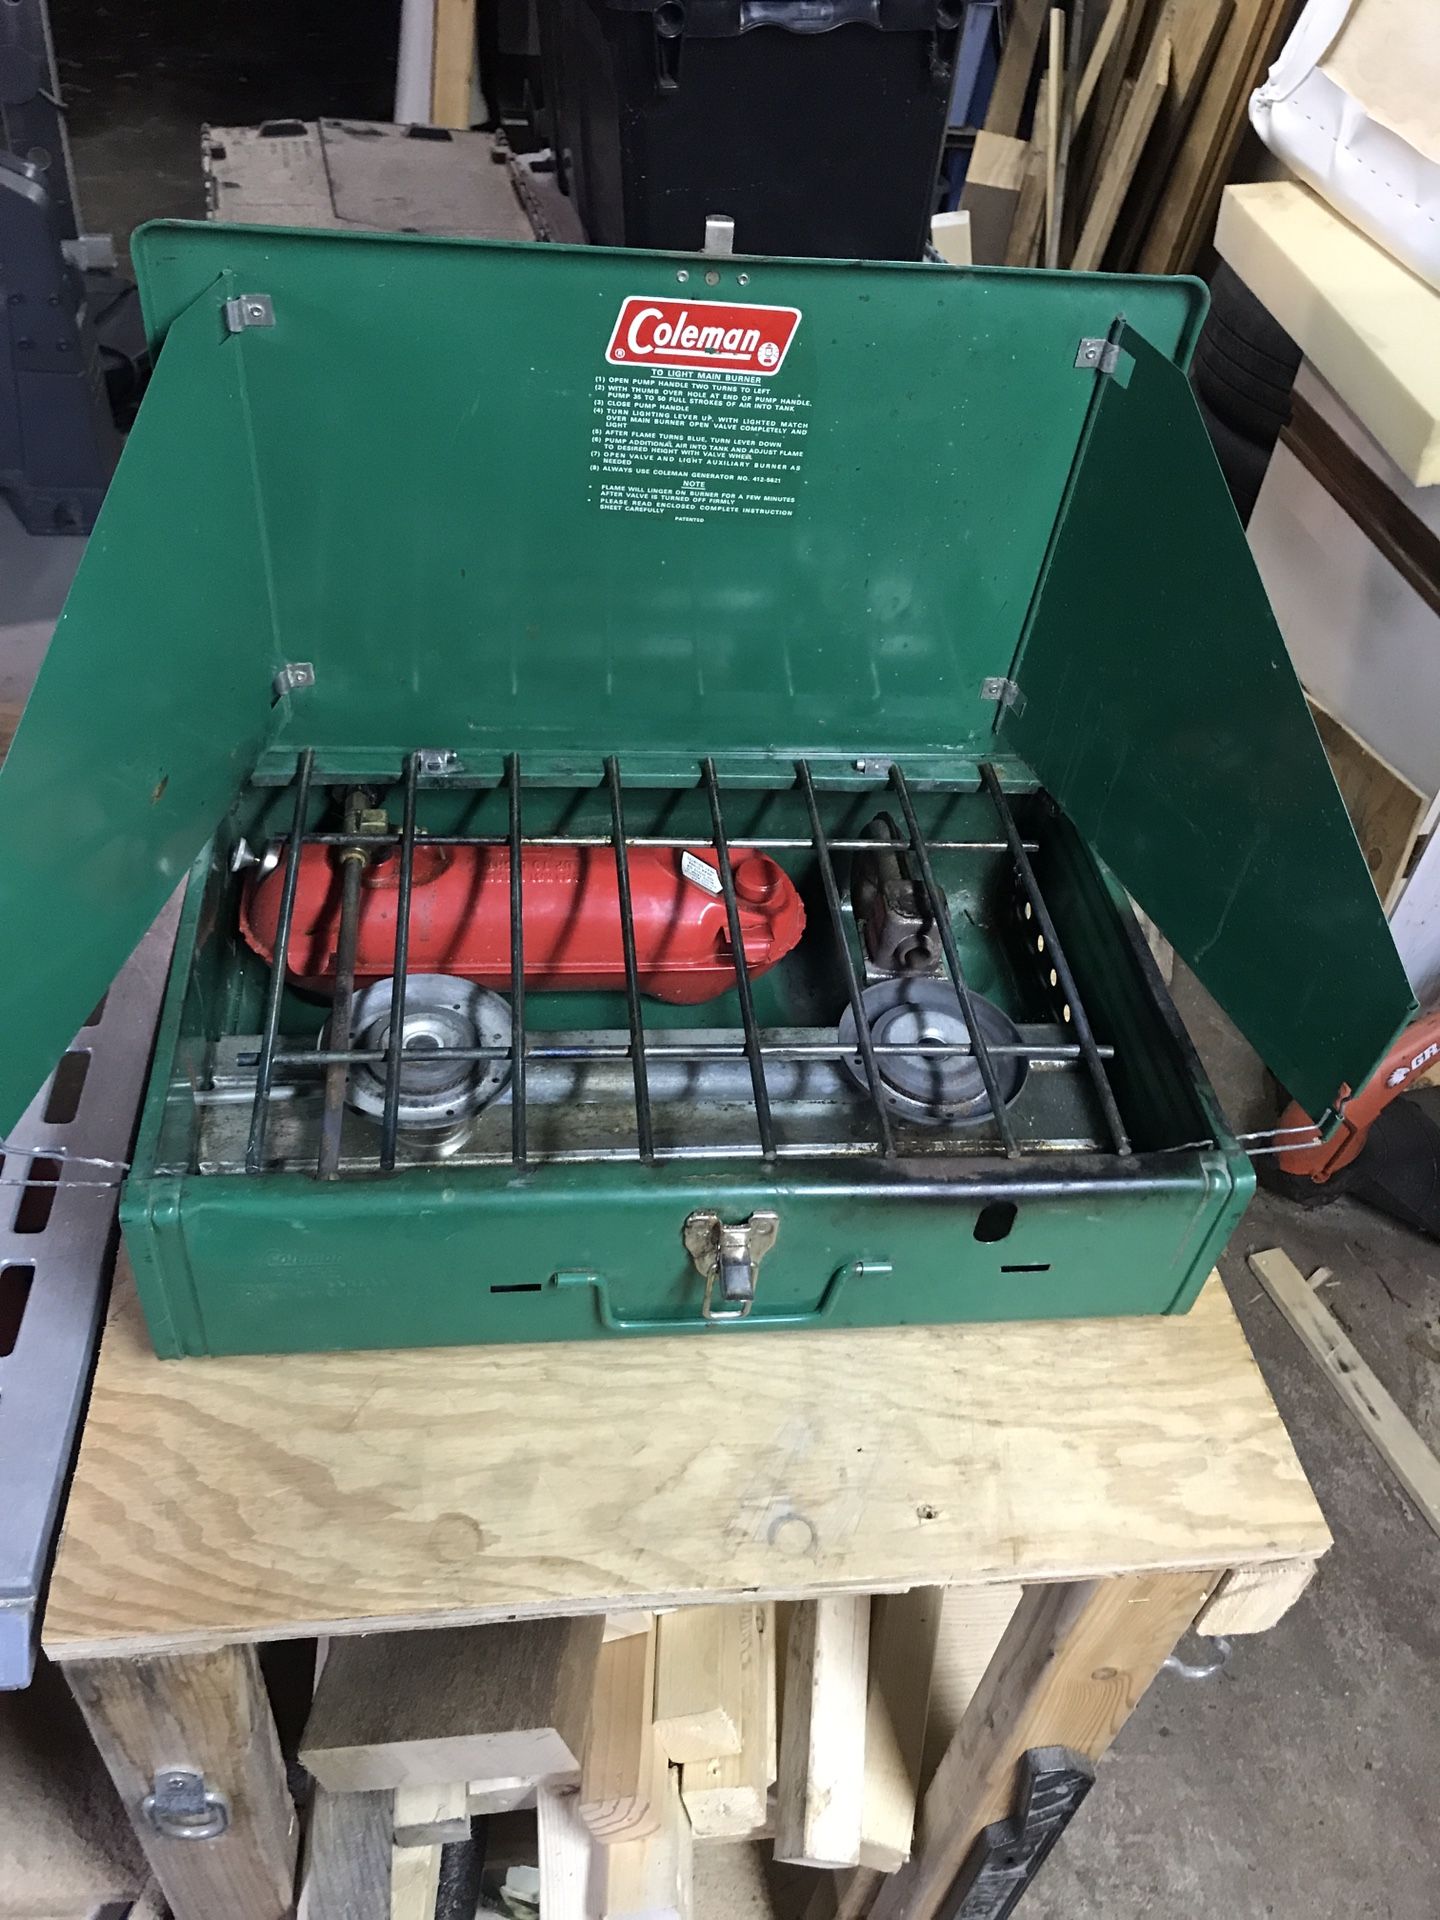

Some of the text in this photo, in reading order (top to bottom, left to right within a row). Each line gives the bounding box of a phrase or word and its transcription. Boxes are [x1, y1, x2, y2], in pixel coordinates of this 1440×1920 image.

[627, 307, 761, 355] Coleman
[668, 370, 694, 378] LIGHT
[697, 372, 720, 380] MAIN
[726, 375, 761, 383] BURNER
[690, 398, 722, 406] STROKES
[740, 425, 787, 434] COMPLETELY
[707, 459, 750, 467] AUXILIARY
[754, 462, 787, 470] BURNER
[692, 472, 734, 480] GENERATOR
[743, 508, 792, 516] INSTRUCTION
